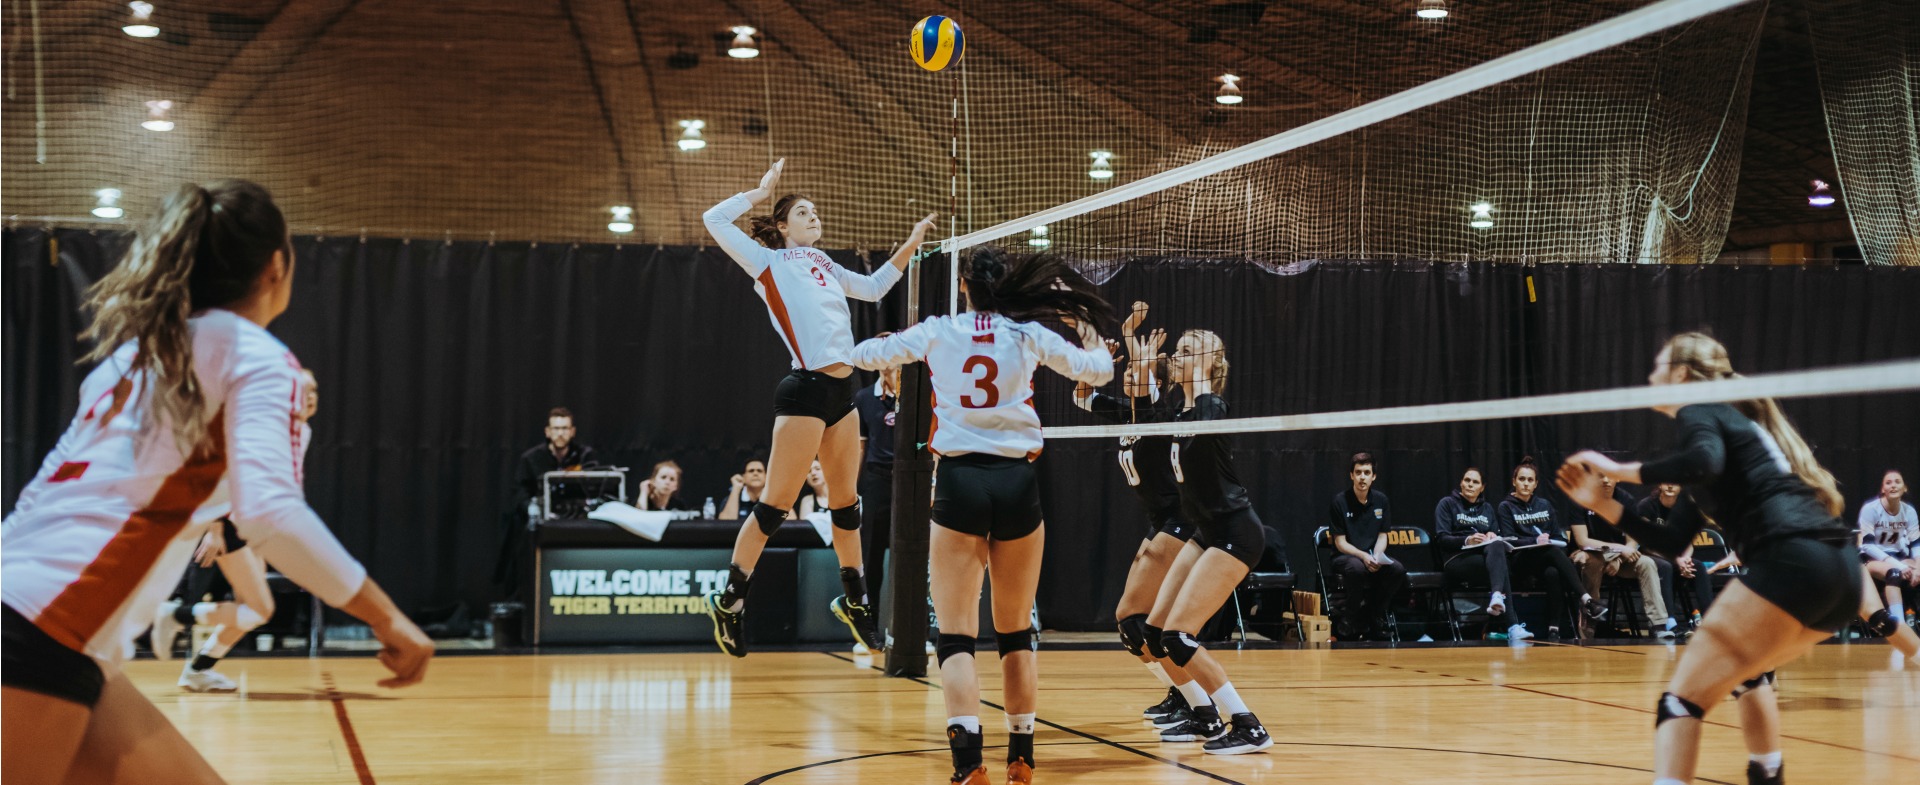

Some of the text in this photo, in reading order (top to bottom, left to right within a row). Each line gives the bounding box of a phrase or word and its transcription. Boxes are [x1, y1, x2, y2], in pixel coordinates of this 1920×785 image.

[783, 250, 834, 273] MEMORIAL
[810, 266, 827, 287] 9
[960, 354, 1000, 409] 3
[1118, 449, 1141, 486] 10
[1388, 530, 1422, 545] DAL
[1692, 531, 1715, 546] AL
[1879, 531, 1899, 545] 14
[550, 569, 691, 595] WELCOME
[550, 596, 611, 615] TIGER
